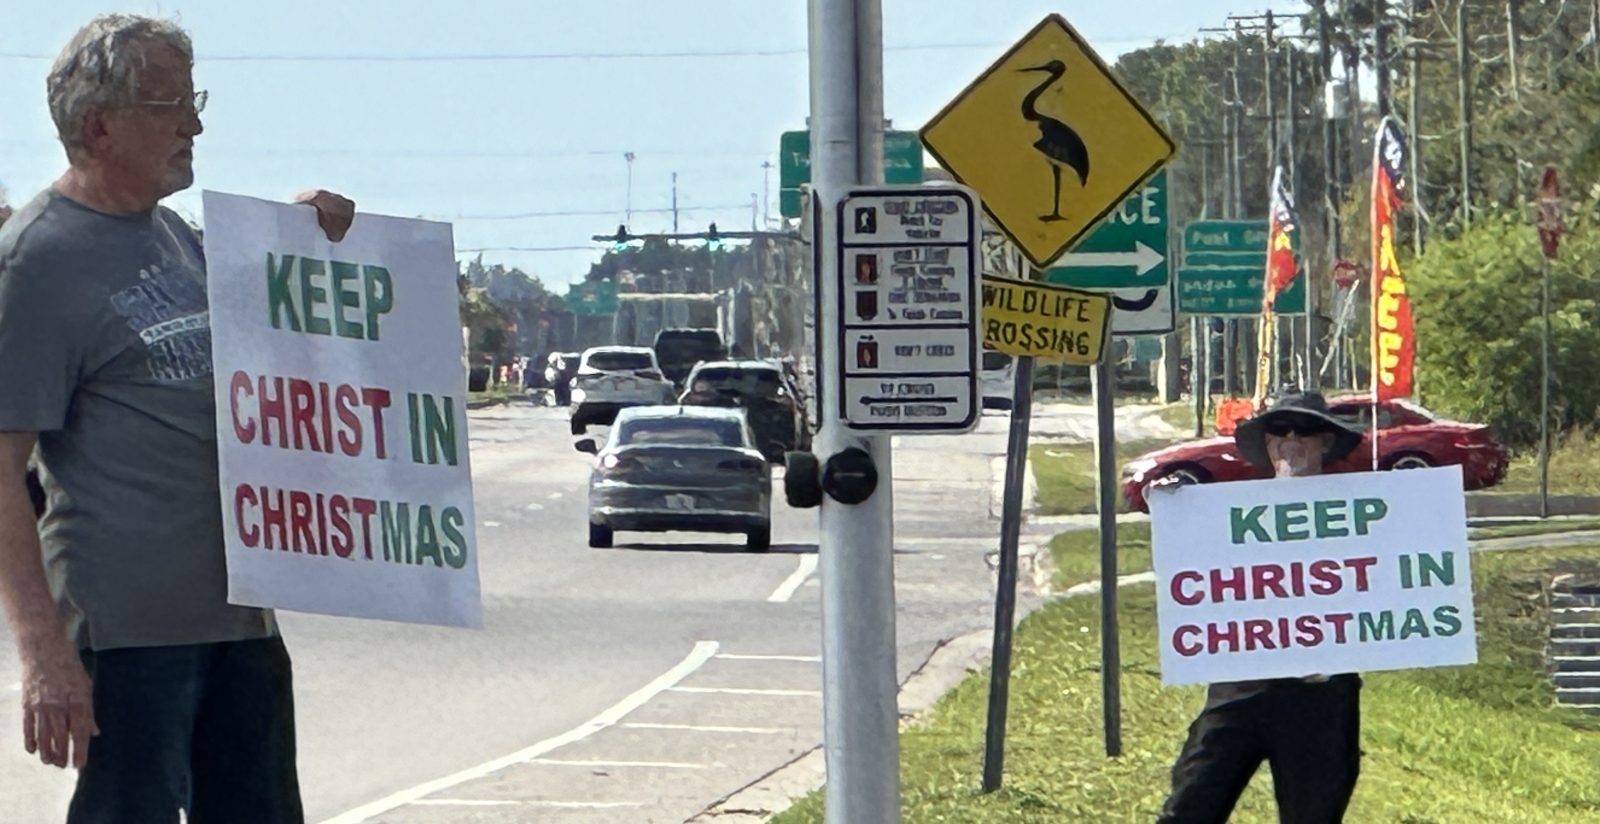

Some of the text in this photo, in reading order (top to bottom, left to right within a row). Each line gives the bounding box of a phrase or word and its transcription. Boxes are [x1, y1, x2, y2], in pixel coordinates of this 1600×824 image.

[1107, 187, 1161, 225] CE
[266, 251, 394, 341] KEEP
[982, 285, 1091, 322] WILDLIFE
[982, 318, 1090, 356] ROSSING
[230, 370, 458, 467] CHRIST IN
[235, 482, 468, 570] CHRISTMAS
[1230, 497, 1388, 545] KEEP
[1170, 551, 1455, 606] CHRIST IN
[1172, 605, 1463, 657] CHRISTMAS
